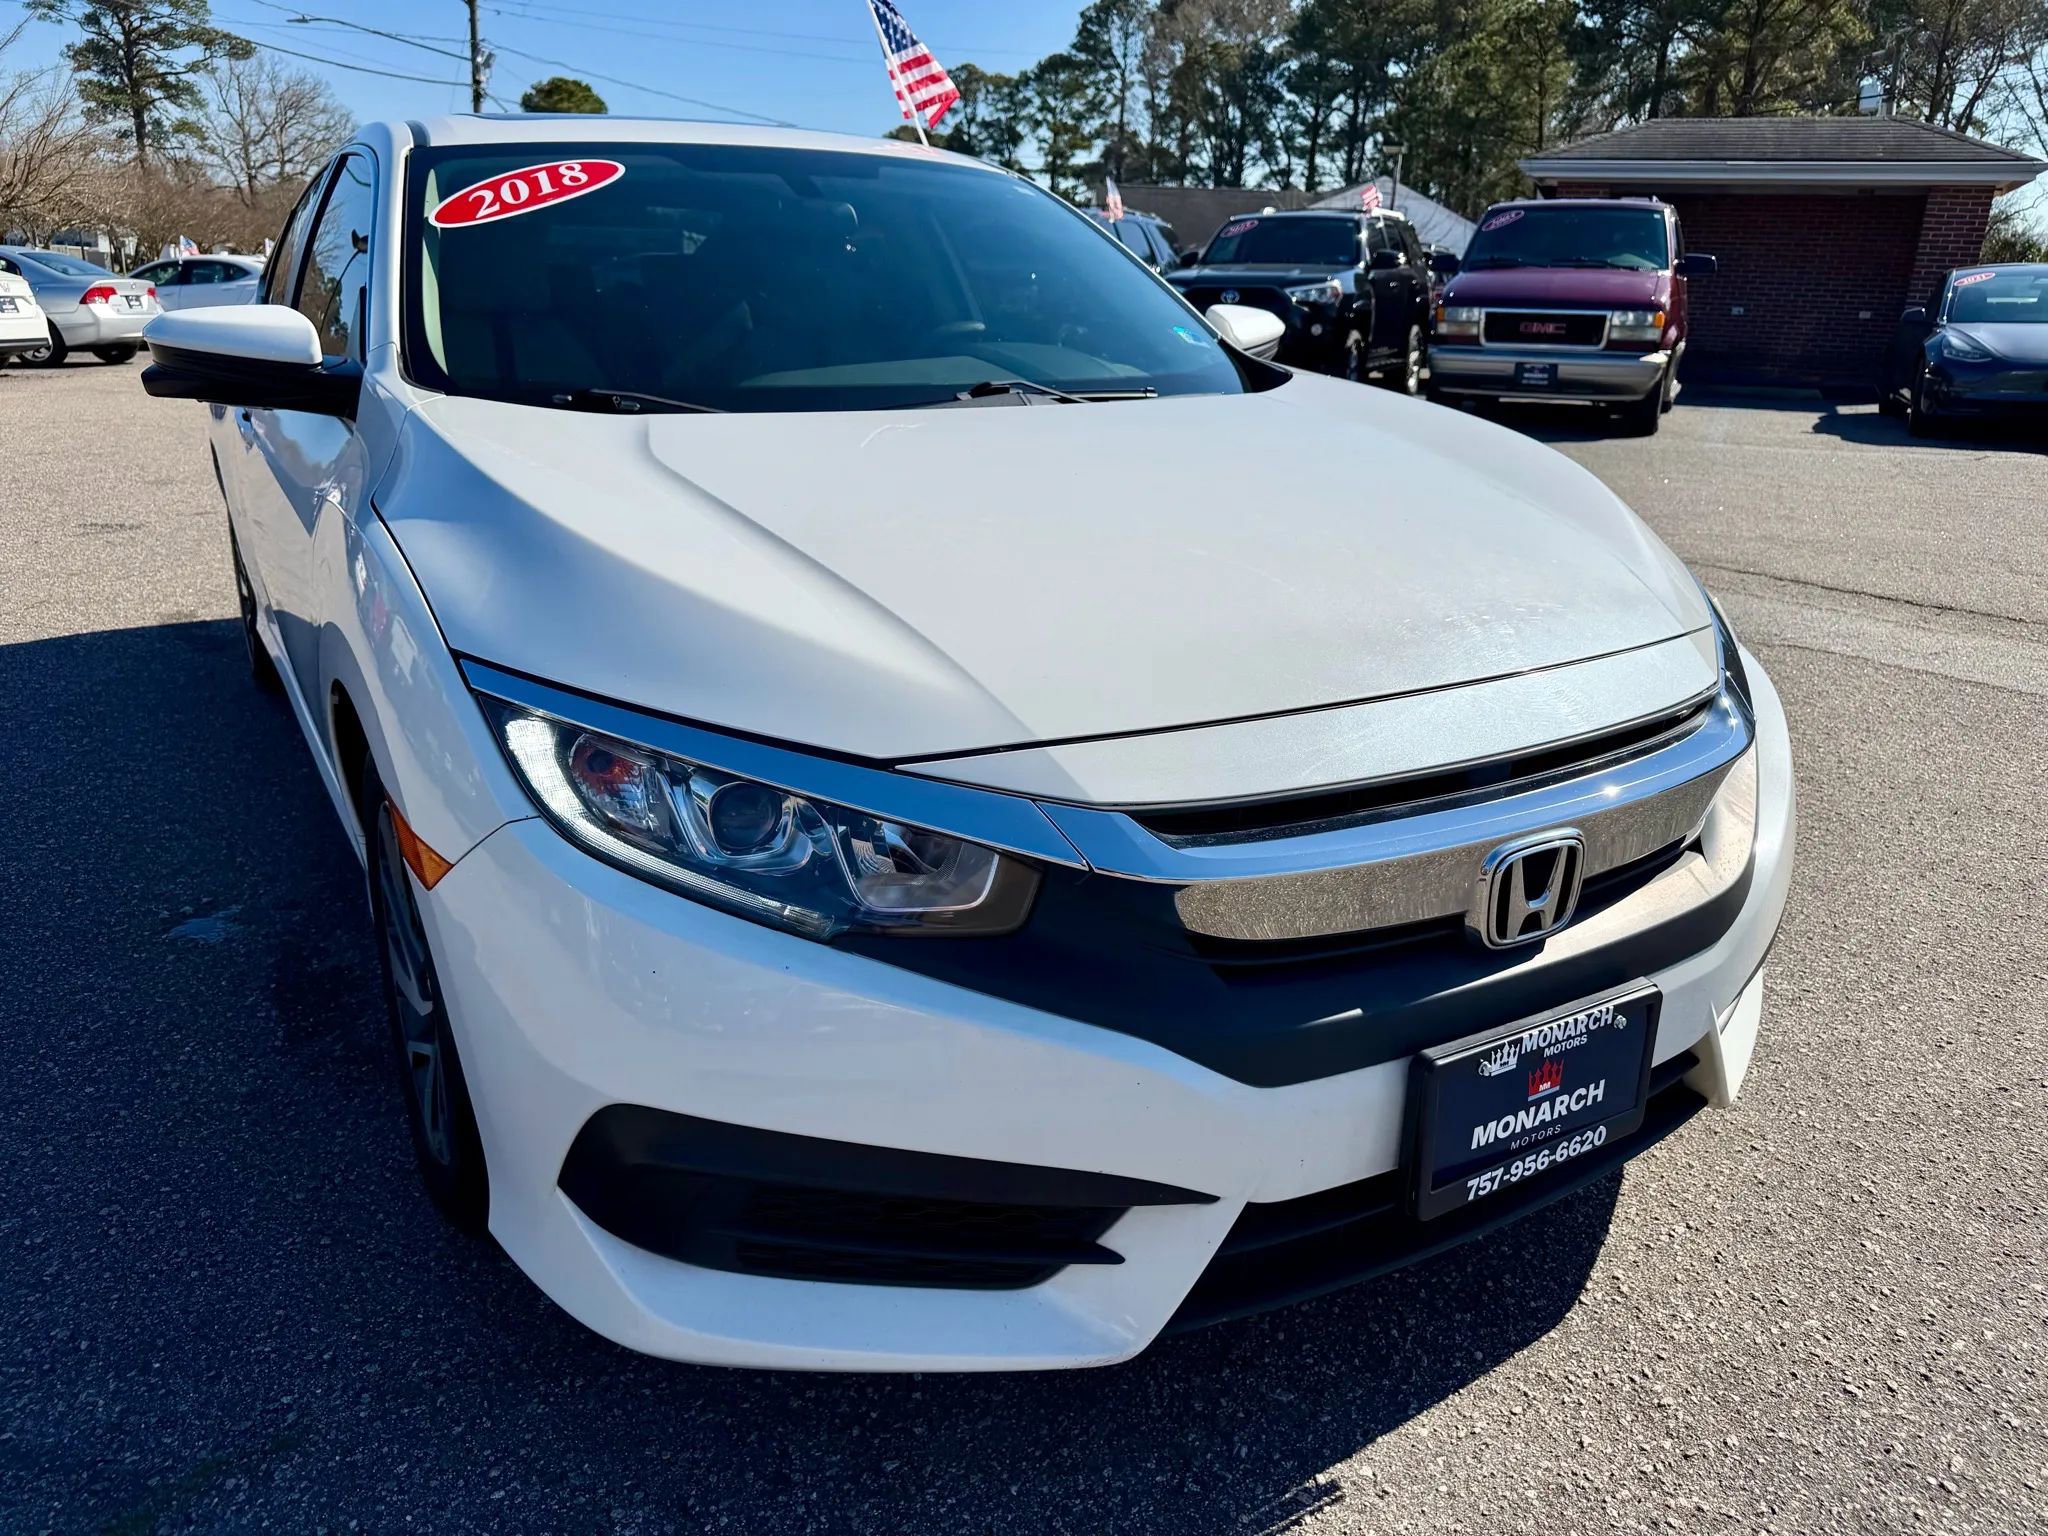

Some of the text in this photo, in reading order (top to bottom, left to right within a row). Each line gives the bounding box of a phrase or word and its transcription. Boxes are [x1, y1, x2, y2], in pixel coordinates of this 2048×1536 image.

[468, 163, 588, 219] 2018
[1520, 322, 1566, 334] GMC
[1522, 1006, 1614, 1054] MONARCH
[1544, 1034, 1587, 1058] MOTORS
[1471, 1079, 1605, 1149] MONARCH
[1511, 1124, 1562, 1150] MOTORS
[1467, 1125, 1607, 1200] 757-956-6620
